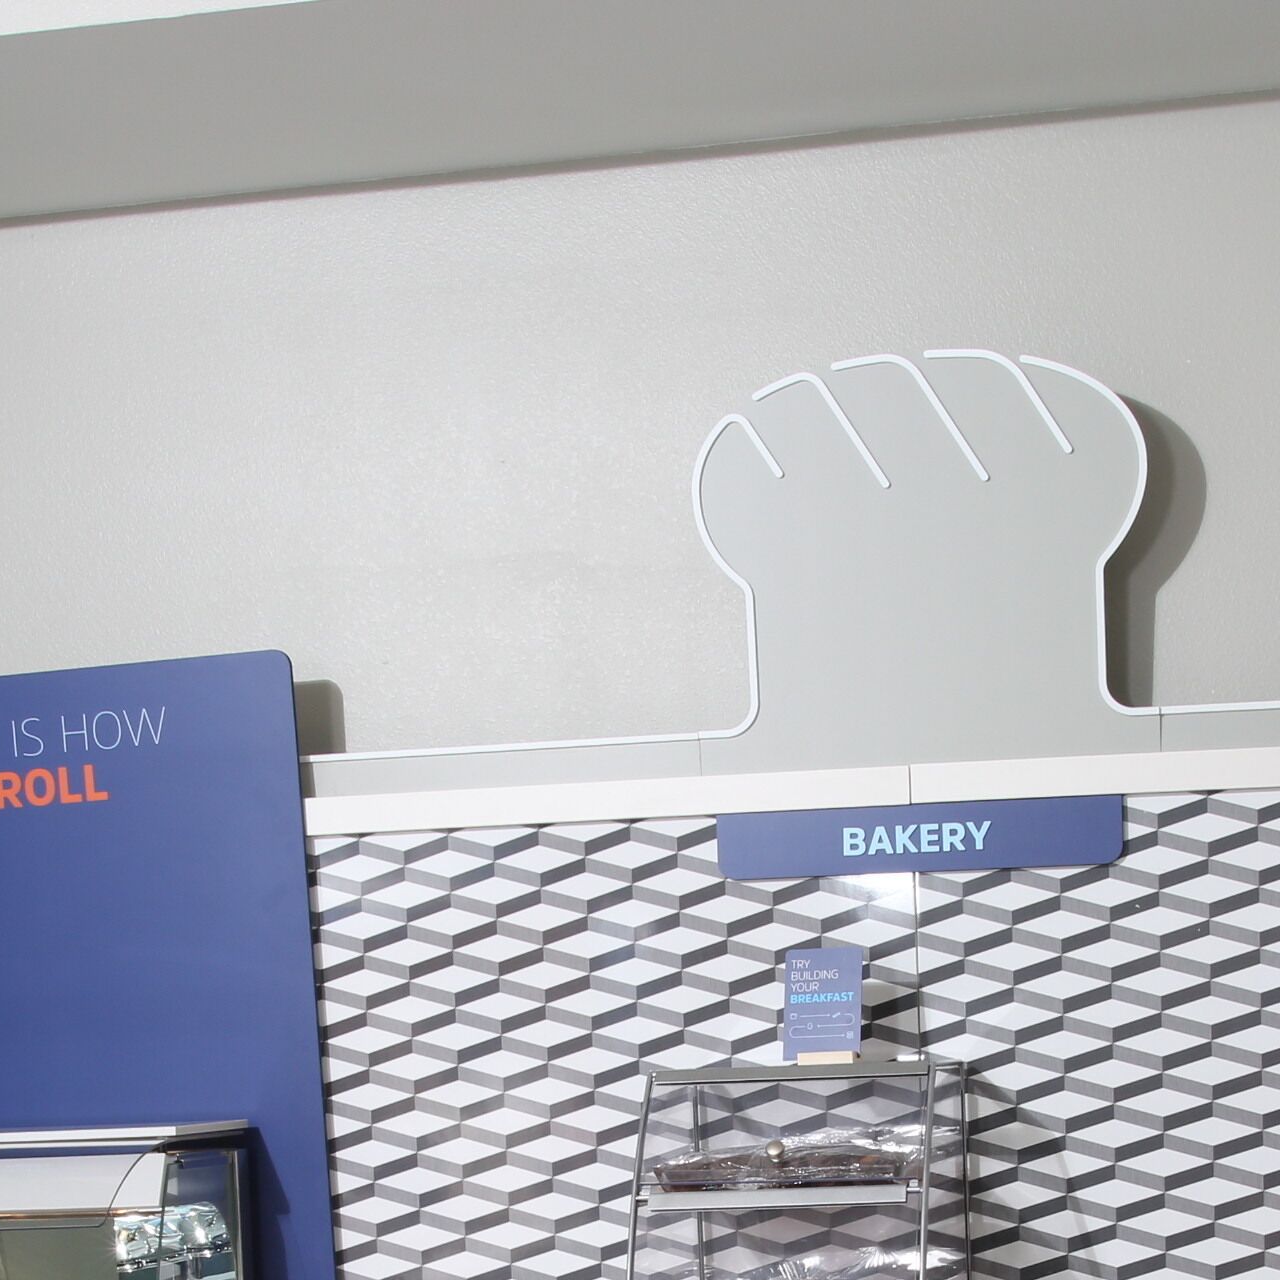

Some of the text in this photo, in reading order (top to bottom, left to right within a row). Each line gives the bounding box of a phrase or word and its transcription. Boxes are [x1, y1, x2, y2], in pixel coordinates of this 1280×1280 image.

[11, 717, 45, 758] IS
[61, 706, 166, 753] HOW
[842, 820, 992, 857] BAKERY
[791, 959, 811, 969] TRY
[790, 968, 840, 982] BUILDING
[790, 981, 820, 993] YOUR
[789, 991, 855, 1004] BREAKFAST
